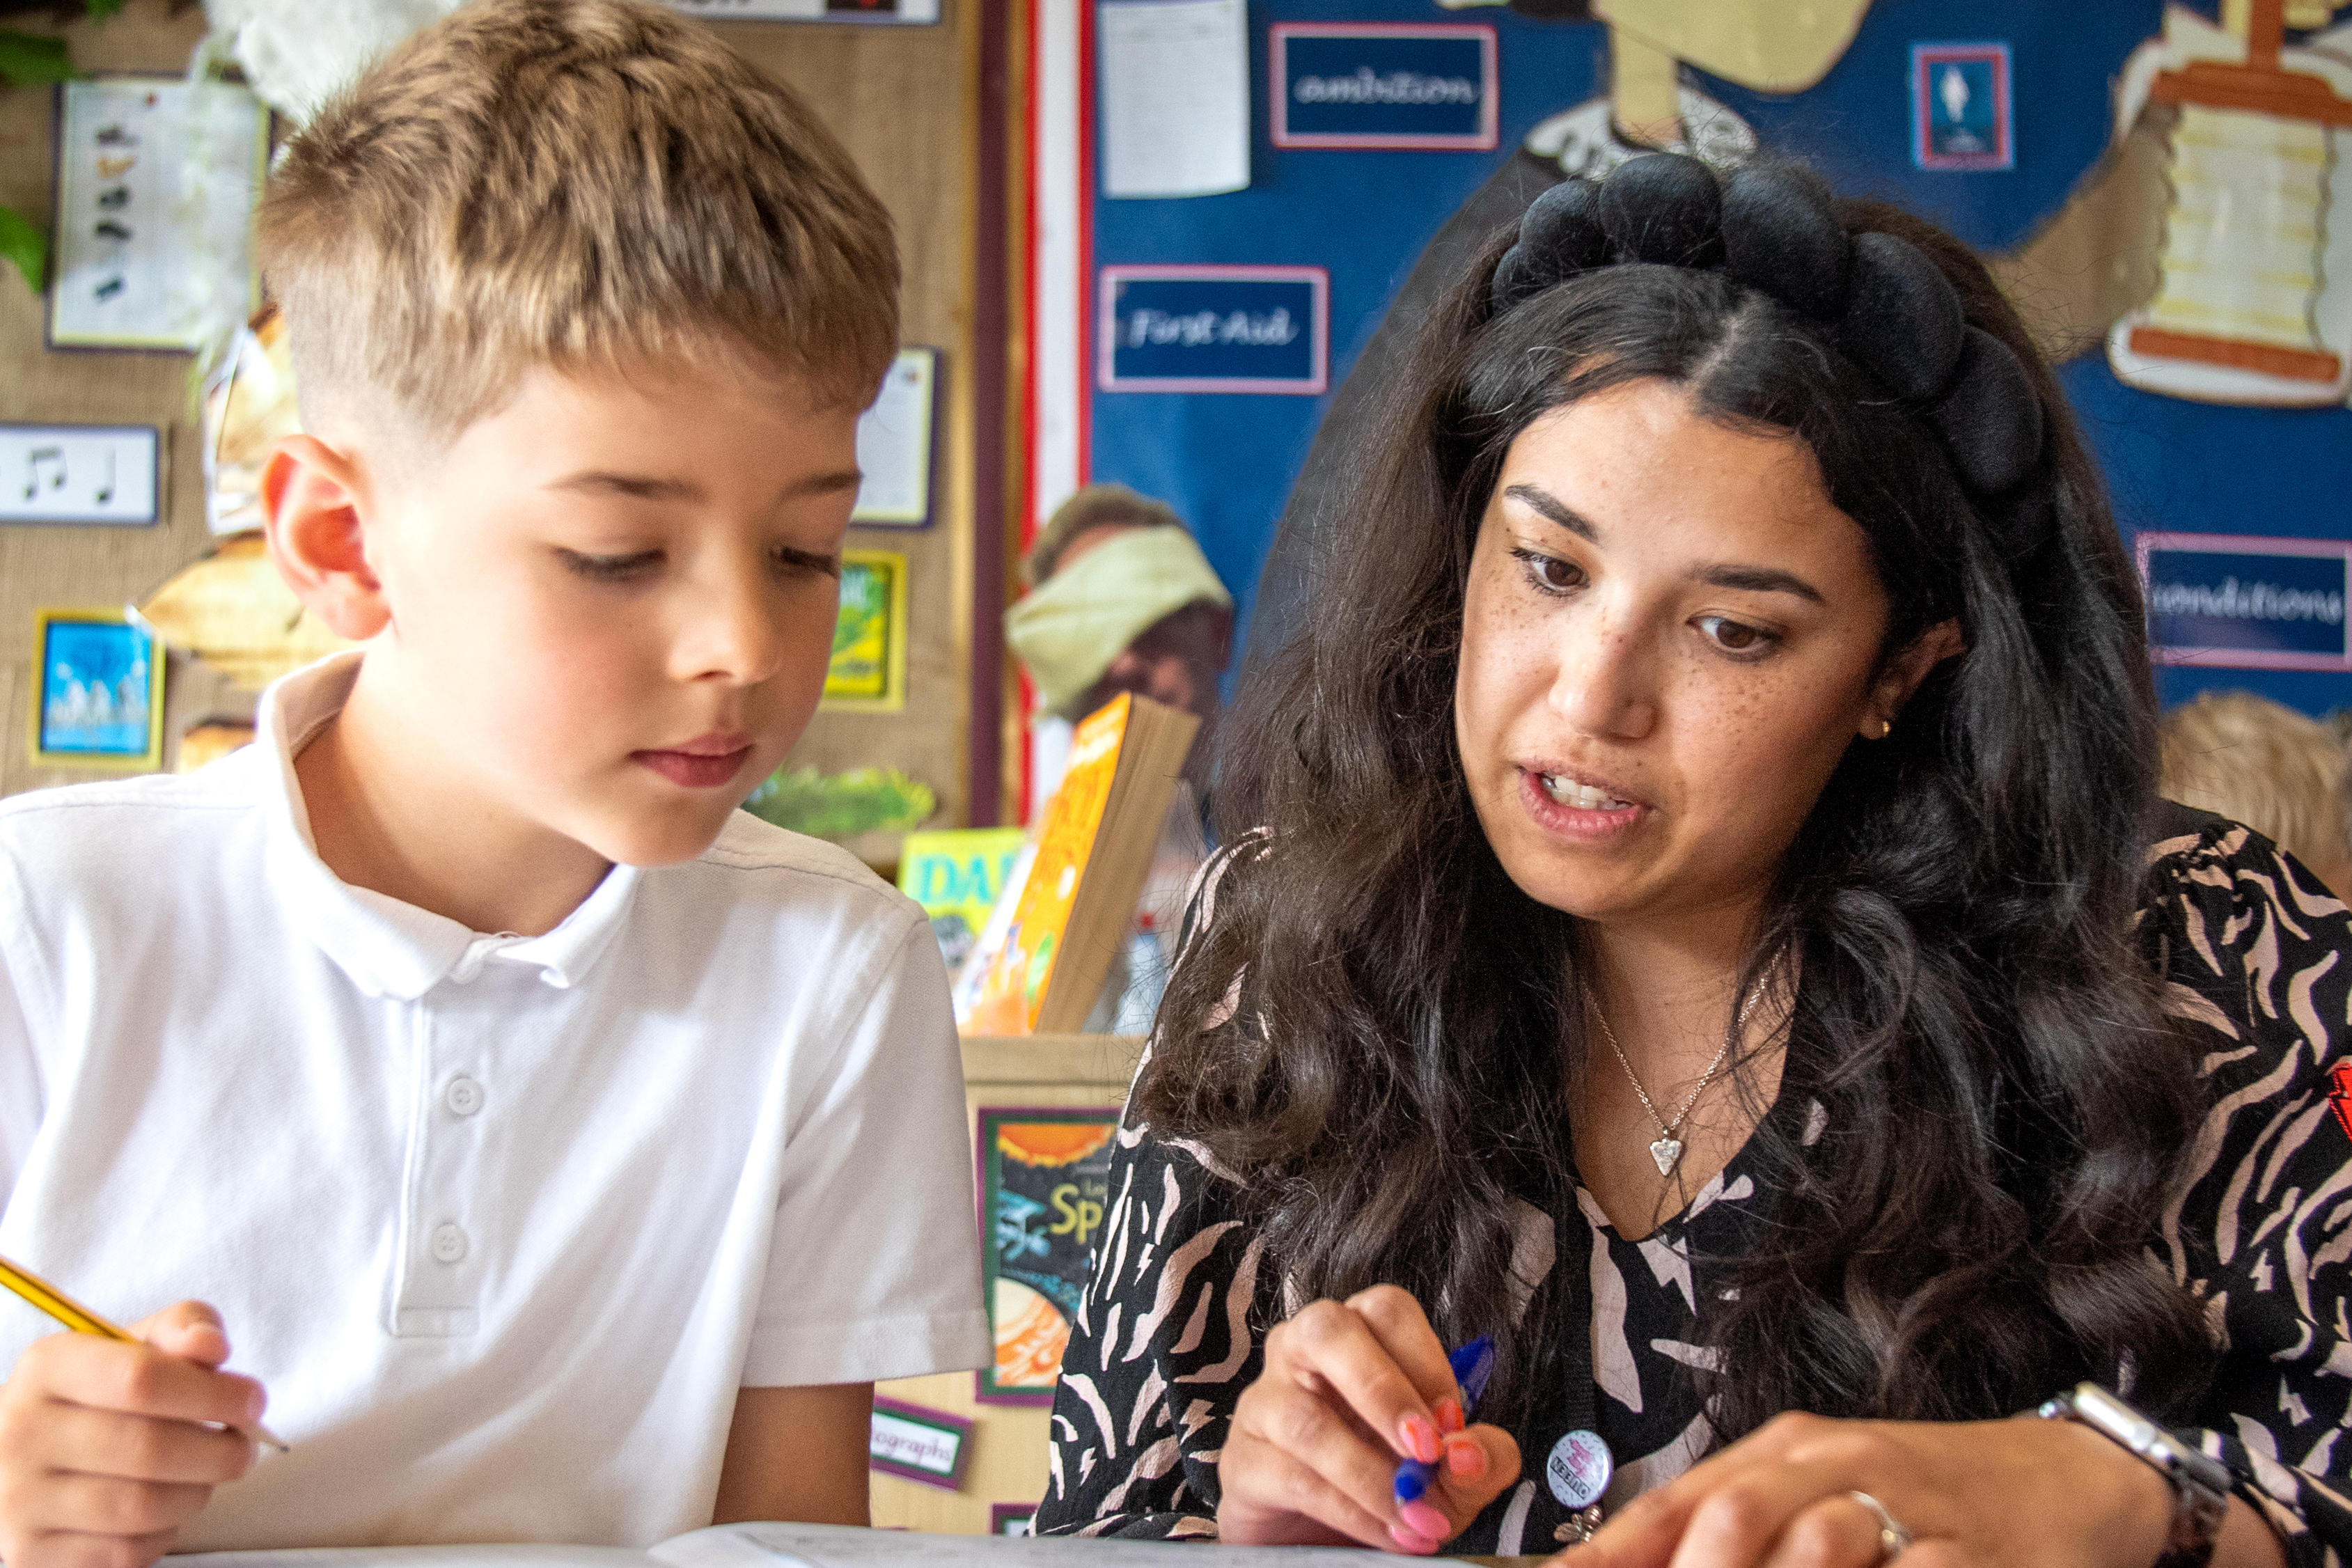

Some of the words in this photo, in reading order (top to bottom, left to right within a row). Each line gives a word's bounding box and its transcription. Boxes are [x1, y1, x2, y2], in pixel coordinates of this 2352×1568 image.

[1294, 67, 1479, 104] ambition
[1127, 308, 1217, 348] First
[1218, 307, 1300, 346] Aid
[1050, 1184, 1103, 1245] Sp
[873, 1432, 952, 1464] ographs
[1551, 1457, 1590, 1498] QUEEN
